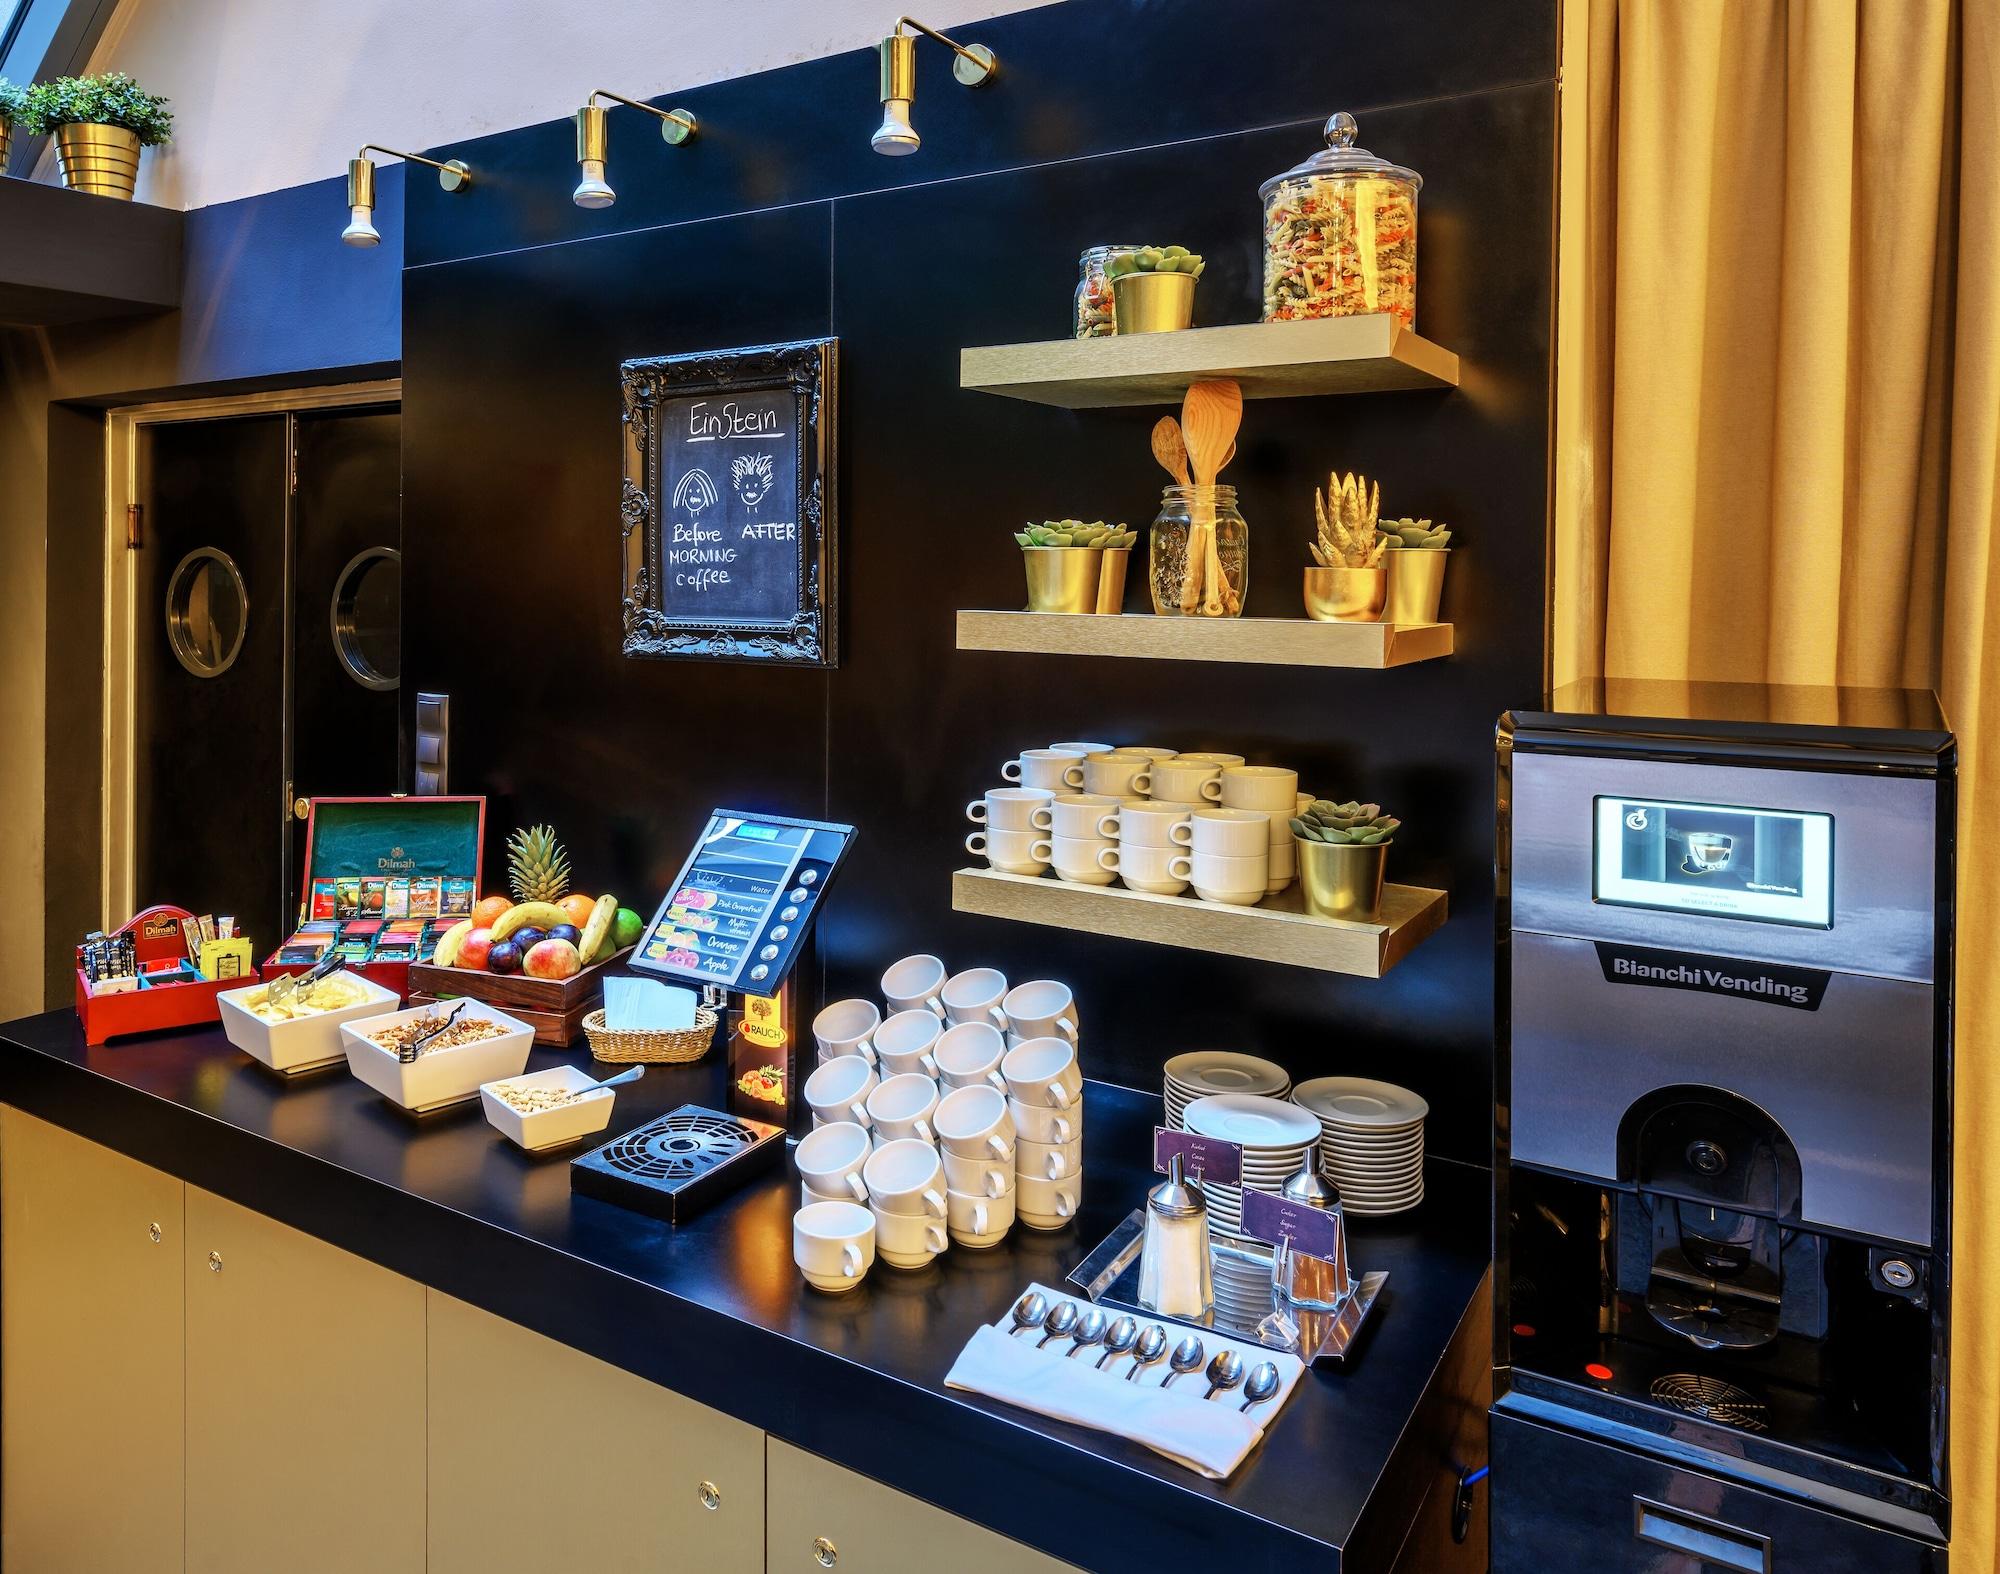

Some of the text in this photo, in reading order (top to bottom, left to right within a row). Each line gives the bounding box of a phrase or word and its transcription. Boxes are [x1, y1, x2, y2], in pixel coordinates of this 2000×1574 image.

[672, 522, 723, 546] Before
[742, 523, 796, 541] AFTER
[669, 548, 738, 565] MORNING
[378, 857, 415, 868] Dilmah
[750, 884, 773, 895] Water
[145, 925, 177, 935] Dilmah
[707, 935, 739, 953] Orange
[703, 956, 729, 972] Apple
[1613, 957, 1809, 1004] Bianchi Vending
[751, 1025, 782, 1040] RAUCH
